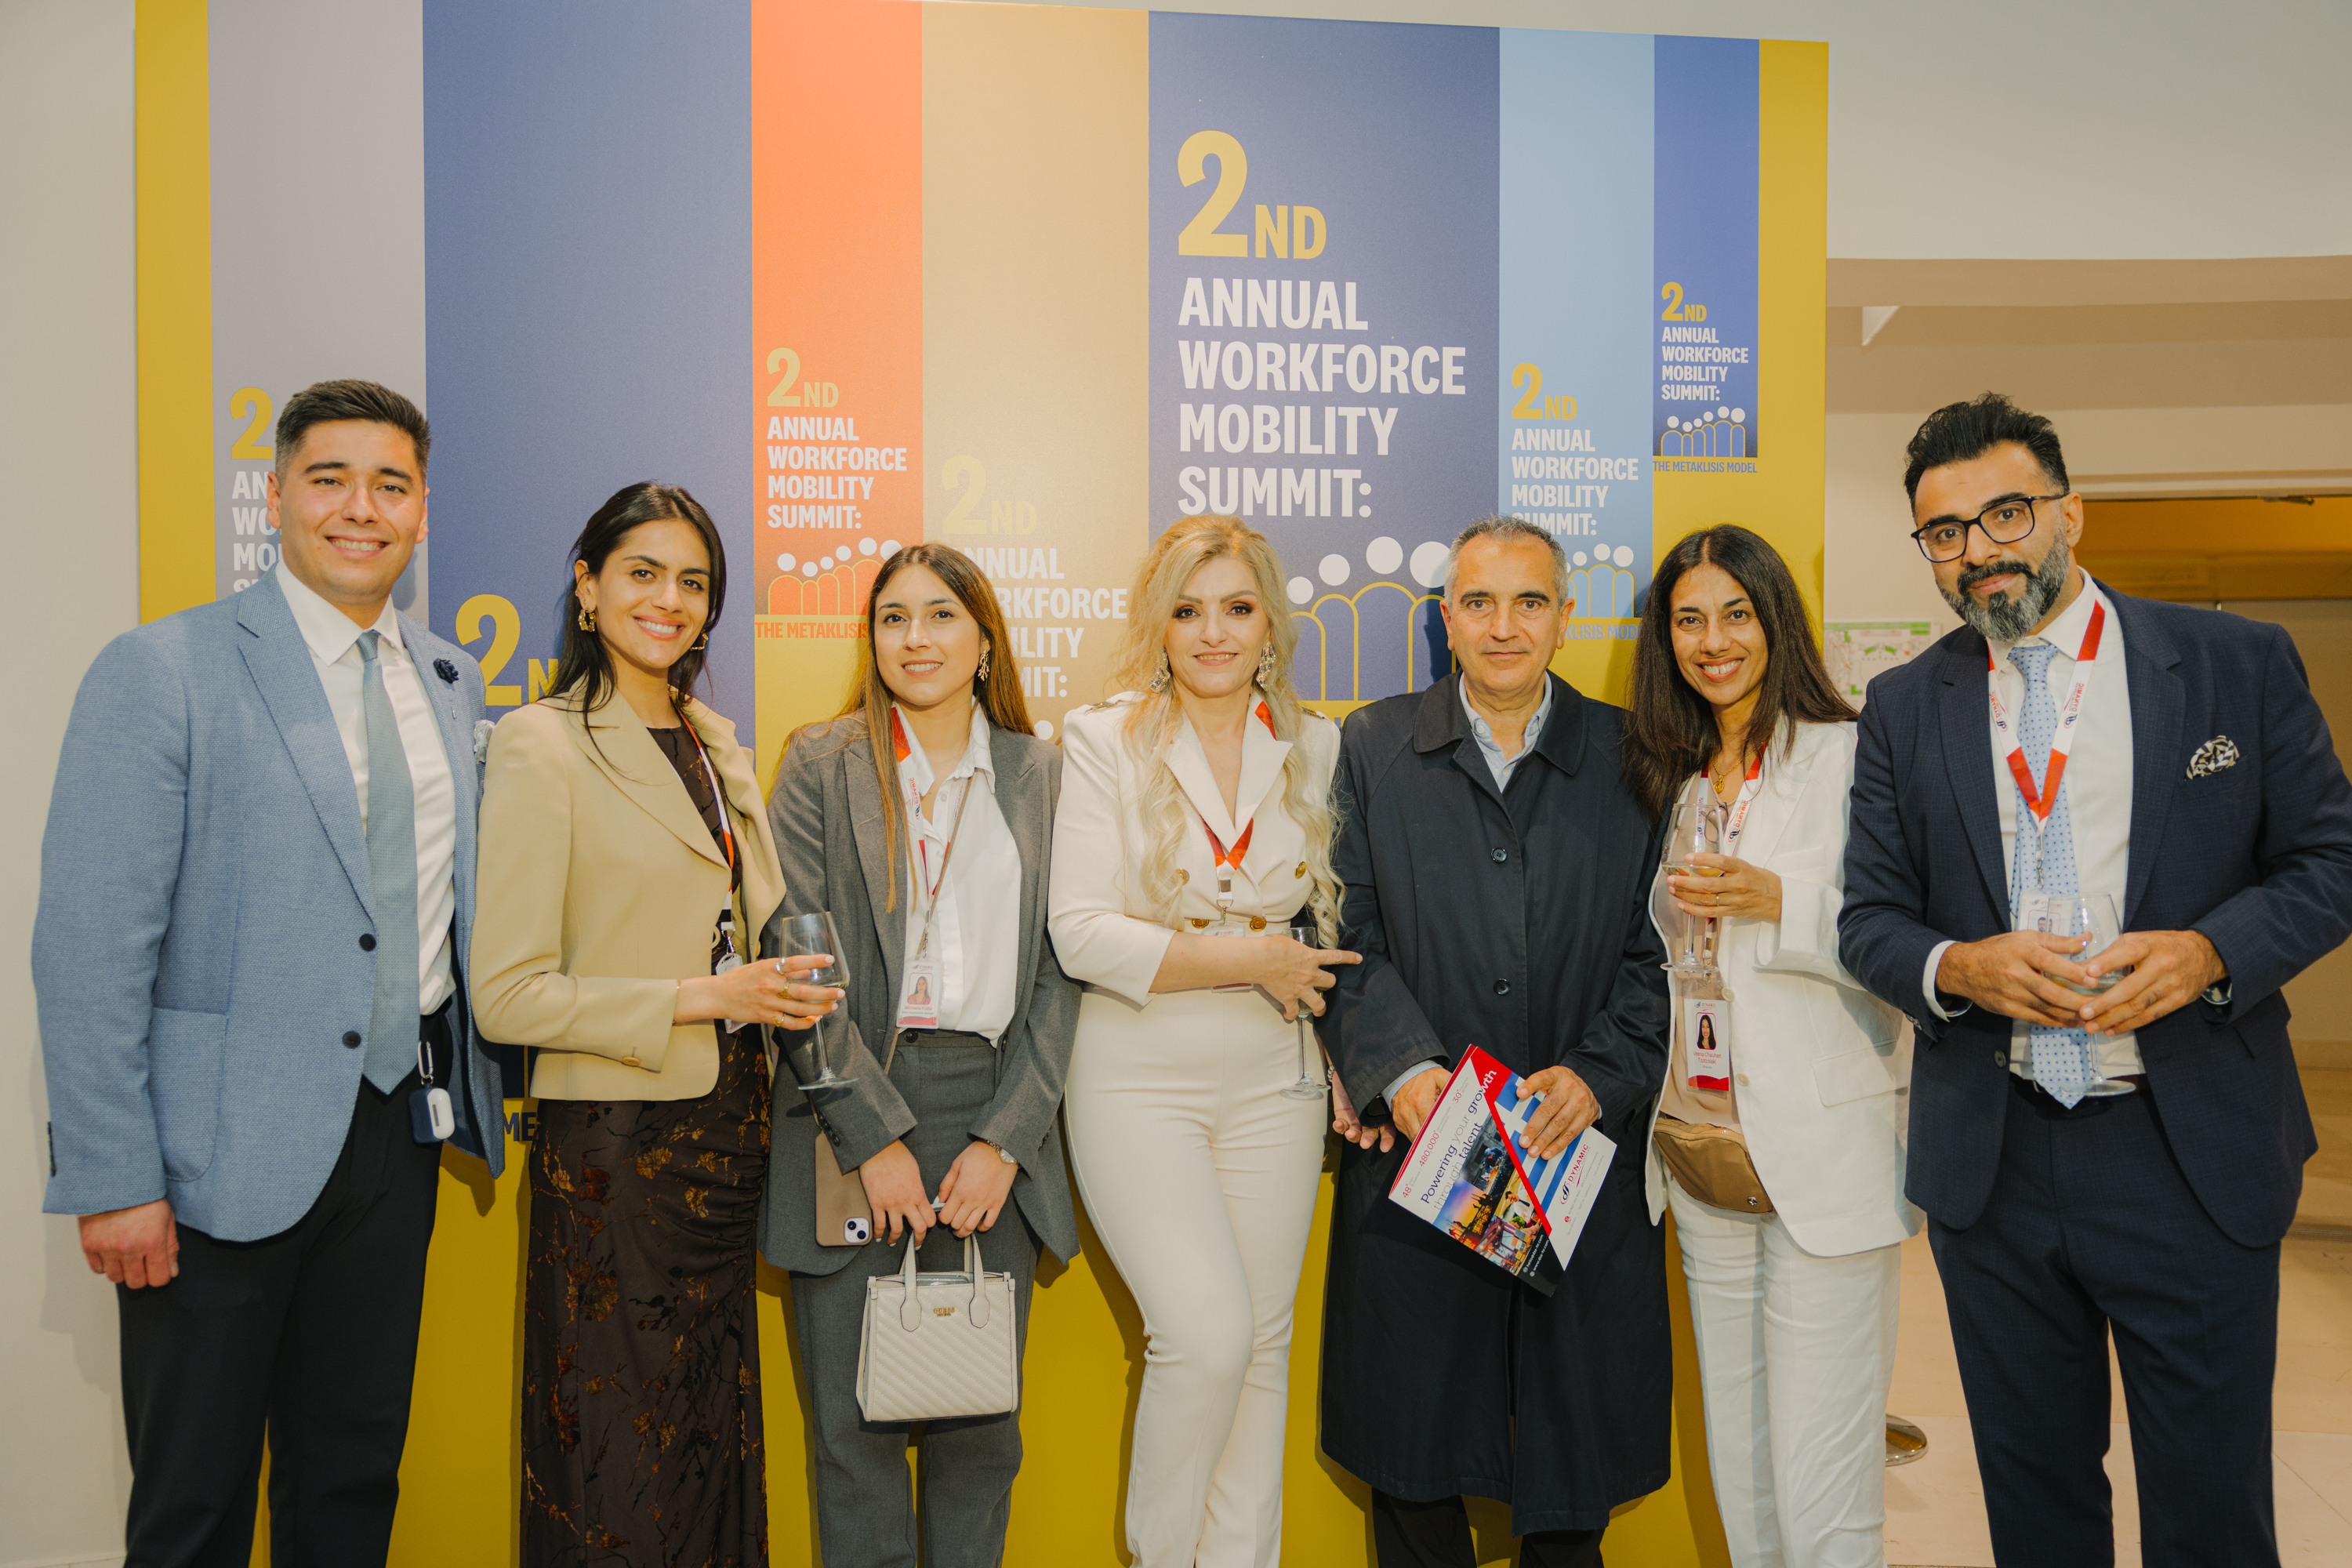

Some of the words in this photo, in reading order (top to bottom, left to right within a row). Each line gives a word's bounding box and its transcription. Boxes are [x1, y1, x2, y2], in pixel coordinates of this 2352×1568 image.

[1178, 130, 1327, 259] 2ND
[1178, 278, 1367, 329] ANNUAL
[1662, 282, 1707, 321] 2ND
[1662, 327, 1719, 343] ANNUAL
[1178, 340, 1465, 394] WORKFORCE
[1662, 346, 1748, 363] WORKFORCE
[767, 348, 839, 408] 2ND
[1662, 365, 1727, 381] MOBILITY
[1512, 363, 1577, 419] 2ND
[1662, 384, 1719, 401] SUMMIT:
[768, 416, 859, 441] ANNUAL
[1181, 404, 1398, 455] MOBILITY
[1512, 429, 1595, 451] ANNUAL
[768, 446, 907, 470] WORKFORCE
[1512, 456, 1638, 480] WORKFORCE
[1653, 461, 1671, 472] THE
[1672, 461, 1725, 473] METAKLISIS
[1727, 463, 1758, 473] MODEL
[768, 475, 874, 499] MOBILITY
[942, 455, 1037, 535] 2ND
[1178, 466, 1372, 517] SUMMIT:
[1512, 485, 1608, 507] MOBILITY
[768, 505, 862, 528] SUMMIT:
[952, 547, 1065, 579] NNUAL
[993, 587, 1127, 619] RKFORCE
[754, 622, 783, 638] THE
[1010, 627, 1084, 658] ILITY
[1564, 625, 1604, 640] KLISIS
[1607, 625, 1641, 640] MOD
[456, 593, 559, 706] 2N
[1420, 1144, 1457, 1203] Powering
[1452, 1114, 1470, 1144] your
[1468, 1069, 1497, 1113] growth
[1433, 1161, 1462, 1210] through
[1458, 1121, 1482, 1158] talent
[1568, 1144, 1588, 1181] DYNAMIC
